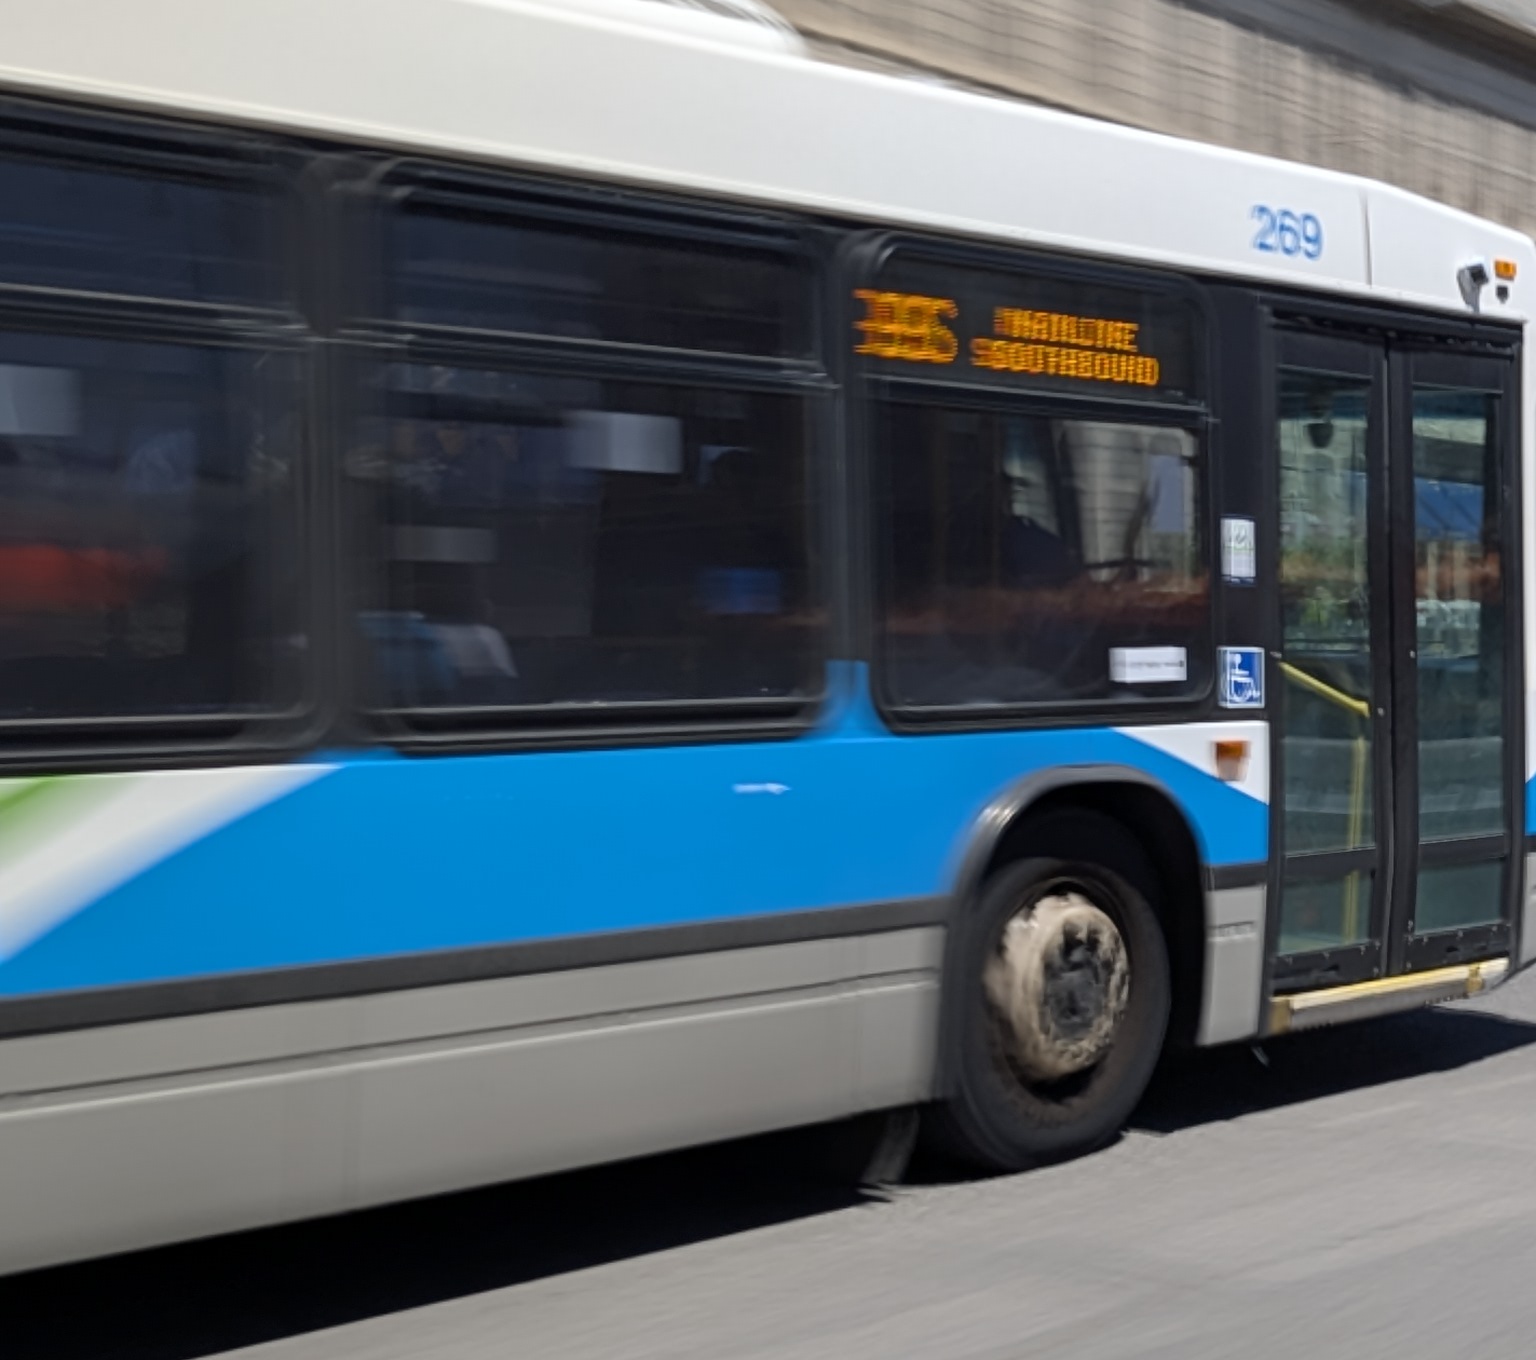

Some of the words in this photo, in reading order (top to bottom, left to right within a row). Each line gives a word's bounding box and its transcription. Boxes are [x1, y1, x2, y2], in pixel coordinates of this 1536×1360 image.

[1250, 204, 1323, 260] 269
[994, 307, 1139, 352] MAINLINE
[970, 338, 1159, 386] SOUTHBOUND
